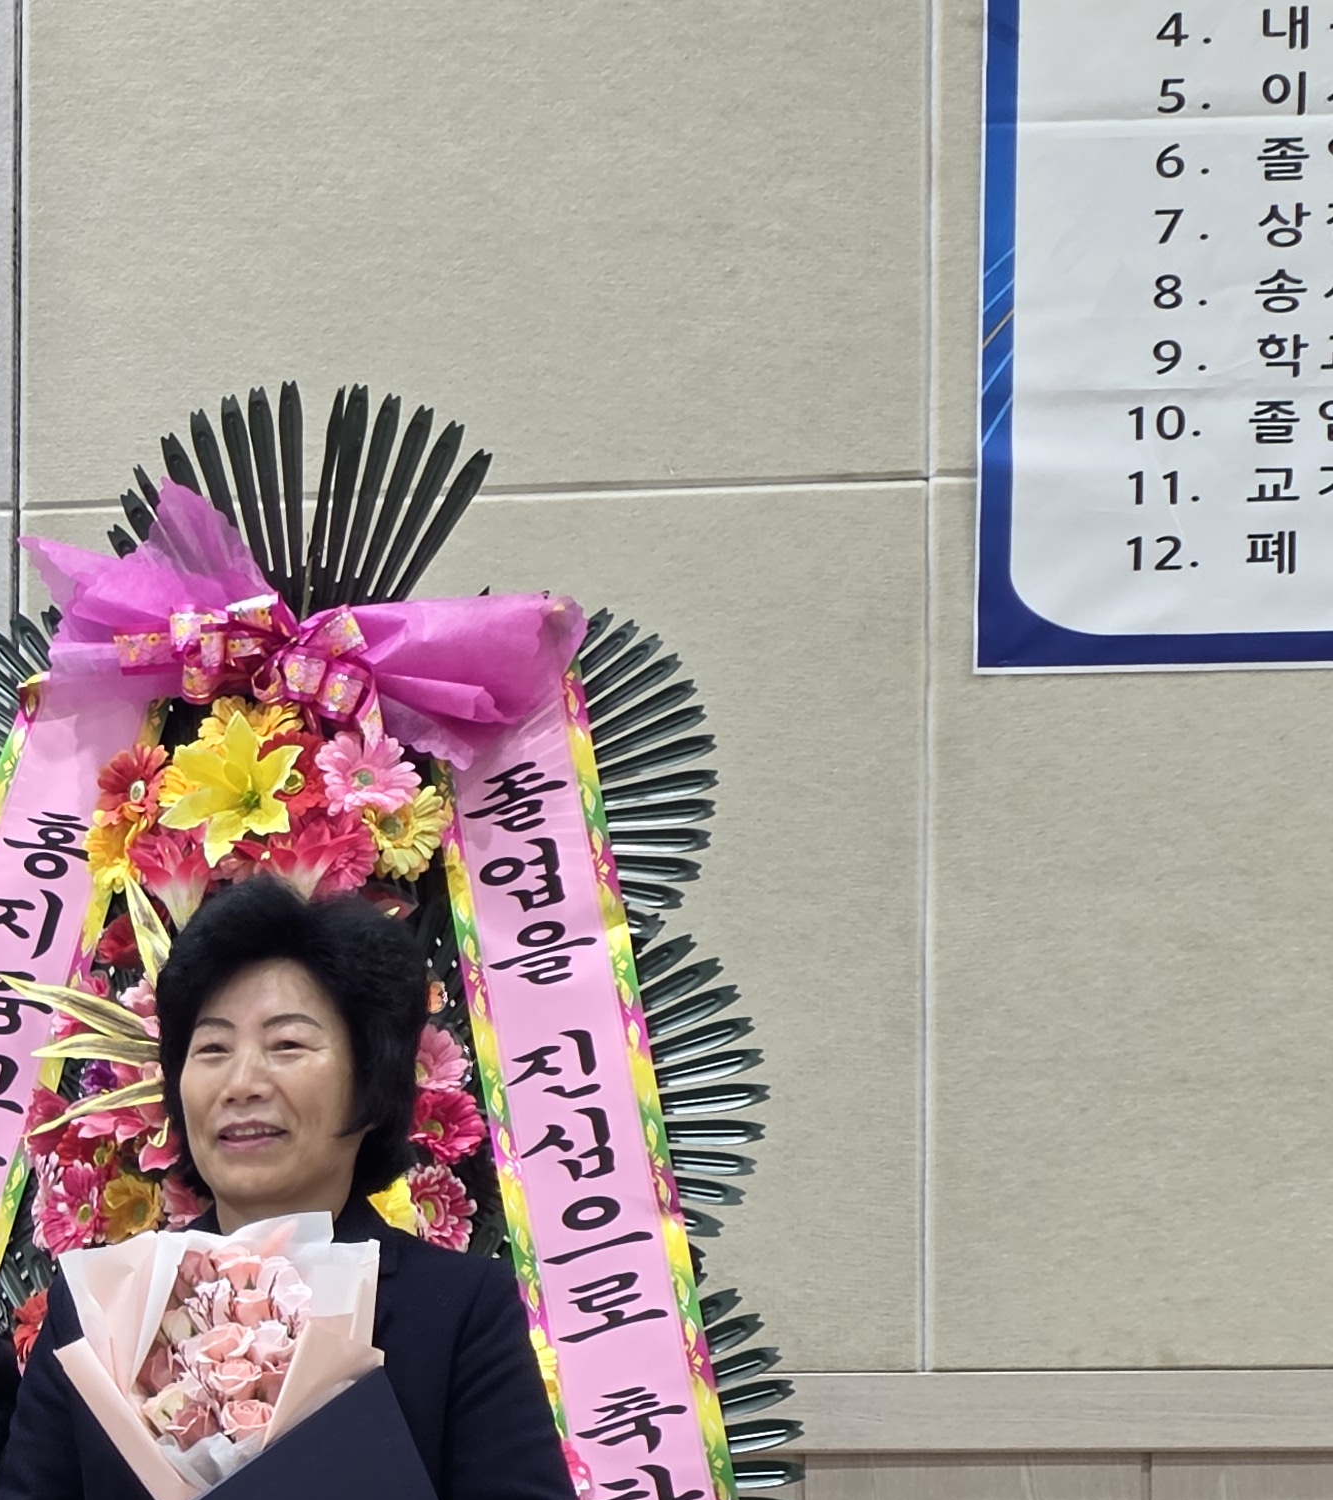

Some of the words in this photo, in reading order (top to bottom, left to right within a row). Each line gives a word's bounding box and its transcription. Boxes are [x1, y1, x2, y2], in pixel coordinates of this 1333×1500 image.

[1156, 12, 1212, 47] 4.
[1263, 5, 1333, 50] 내
[1157, 78, 1211, 114] 5.
[1262, 71, 1333, 116] 이
[1156, 143, 1210, 178] 6.
[1257, 137, 1333, 181] 졸
[1154, 208, 1209, 244] 7.
[1258, 202, 1333, 248] 상
[1153, 274, 1207, 310] 8.
[1255, 268, 1333, 313] 송
[1153, 339, 1207, 375] 9.
[1257, 334, 1333, 378] 학
[1128, 405, 1201, 441] 10.
[1128, 470, 1200, 505] 11.
[1126, 535, 1199, 571] 12.
[1246, 530, 1297, 574] 폐
[464, 760, 597, 985] 졸업을
[507, 1029, 669, 1344] 진심으로
